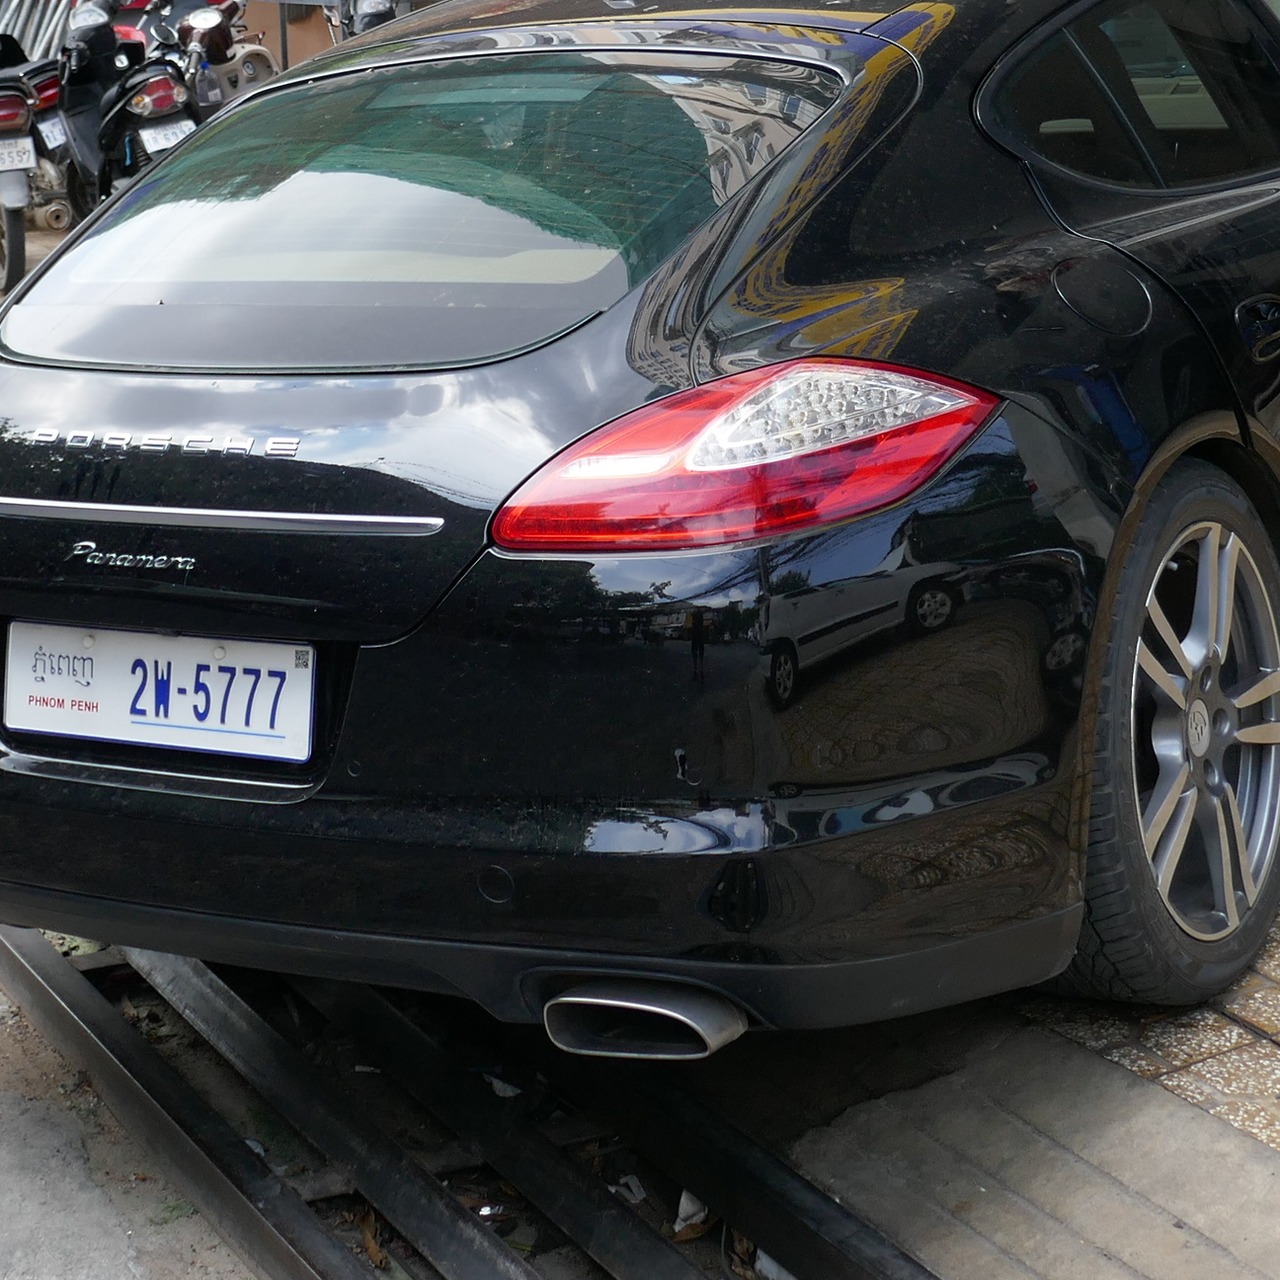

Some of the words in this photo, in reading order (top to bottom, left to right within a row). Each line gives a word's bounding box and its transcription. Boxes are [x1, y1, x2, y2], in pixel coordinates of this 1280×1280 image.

[32, 427, 301, 458] PORSCHE
[64, 541, 196, 570] Panamera
[31, 646, 94, 687] ភ្នំពេញ
[28, 694, 65, 710] PHNOM
[70, 699, 99, 713] PENH
[129, 657, 287, 730] 2W-5777
